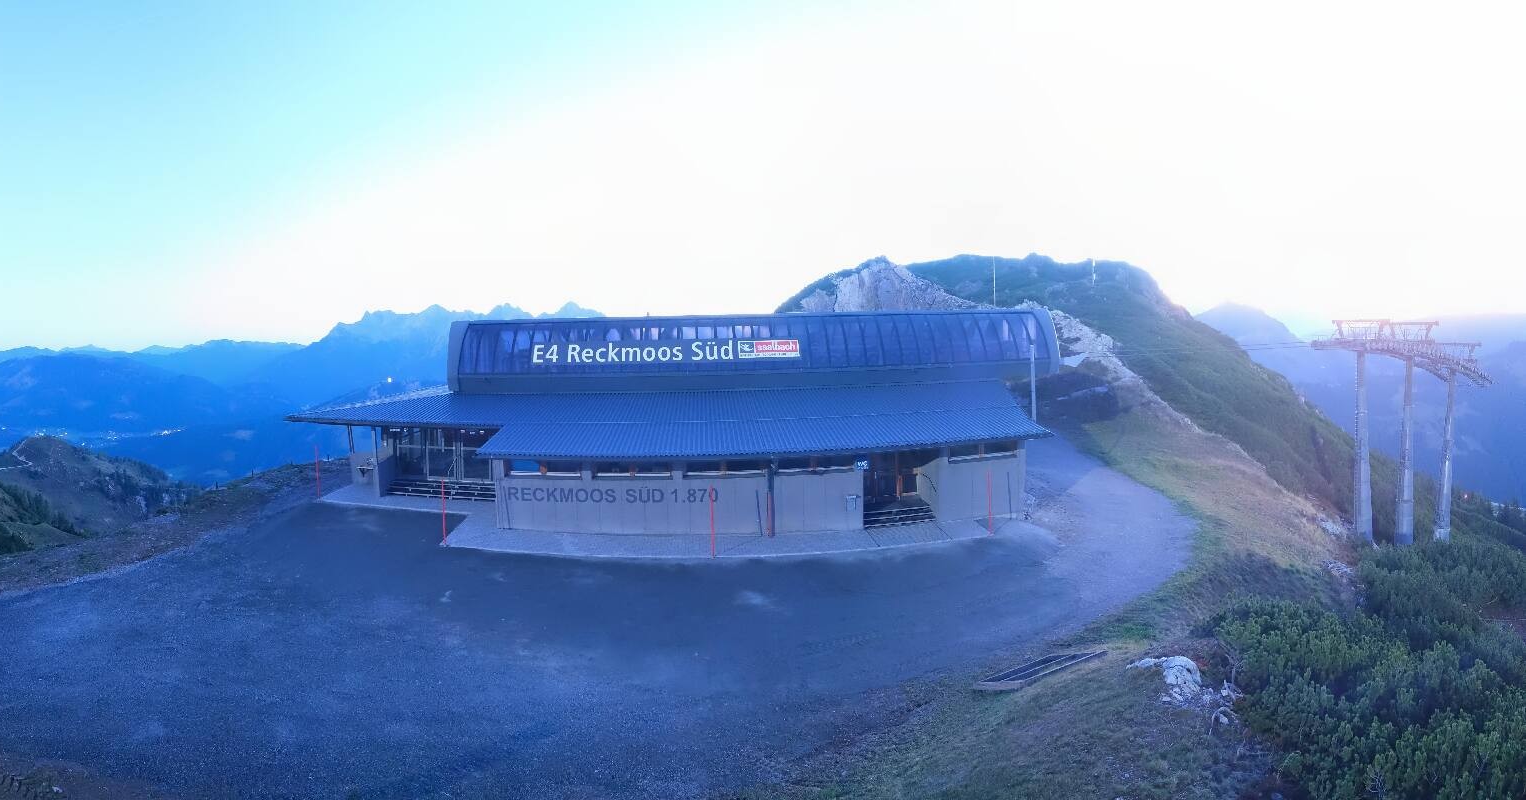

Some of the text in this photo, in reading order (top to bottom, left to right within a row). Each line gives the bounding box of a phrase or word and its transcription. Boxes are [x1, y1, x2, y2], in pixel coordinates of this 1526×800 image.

[532, 340, 734, 363] E4 Reckmoos Süd
[756, 341, 796, 351] saalbach
[507, 486, 719, 504] RECKMOOS SÜD 1.870
